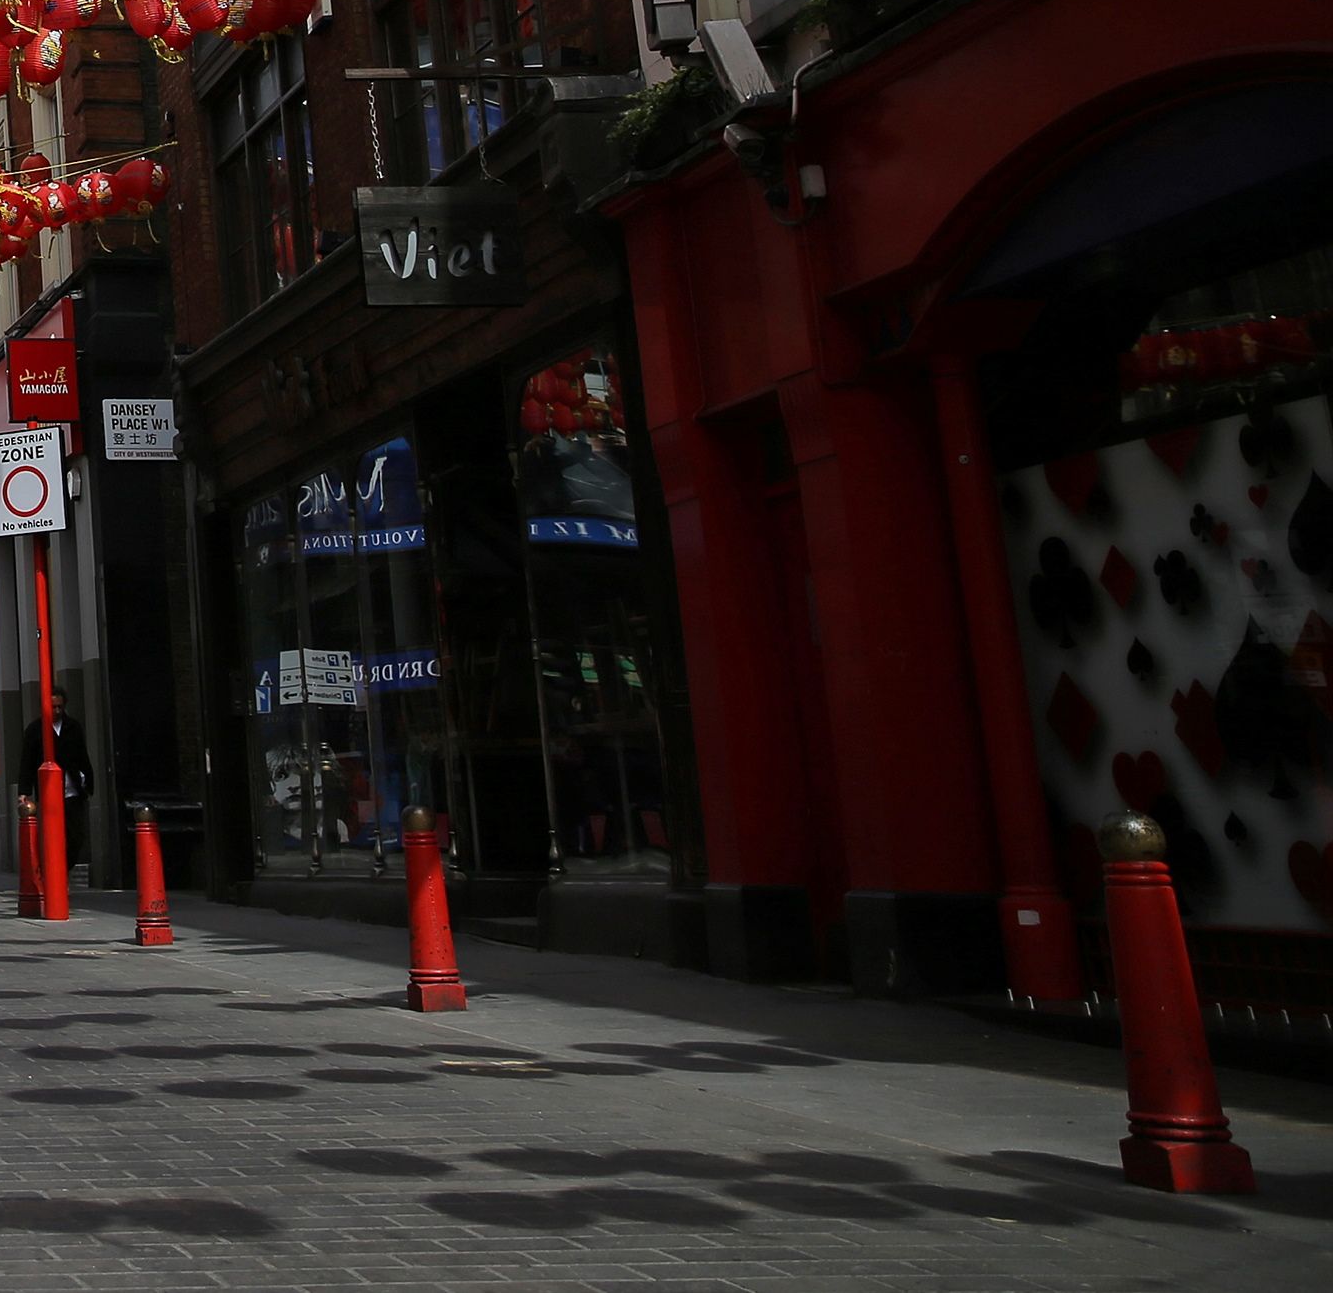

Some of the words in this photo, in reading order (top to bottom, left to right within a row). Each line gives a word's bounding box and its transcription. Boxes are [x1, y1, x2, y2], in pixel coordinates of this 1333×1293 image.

[379, 217, 500, 279] Viet
[19, 366, 68, 383] 山小屋
[20, 384, 69, 394] YAMAGOYA
[111, 404, 157, 416] DANSEY
[112, 418, 147, 430] PLACE
[151, 418, 169, 430] W1
[1, 446, 44, 463] ZONE
[2, 522, 15, 531] No
[17, 518, 53, 529] vehicles
